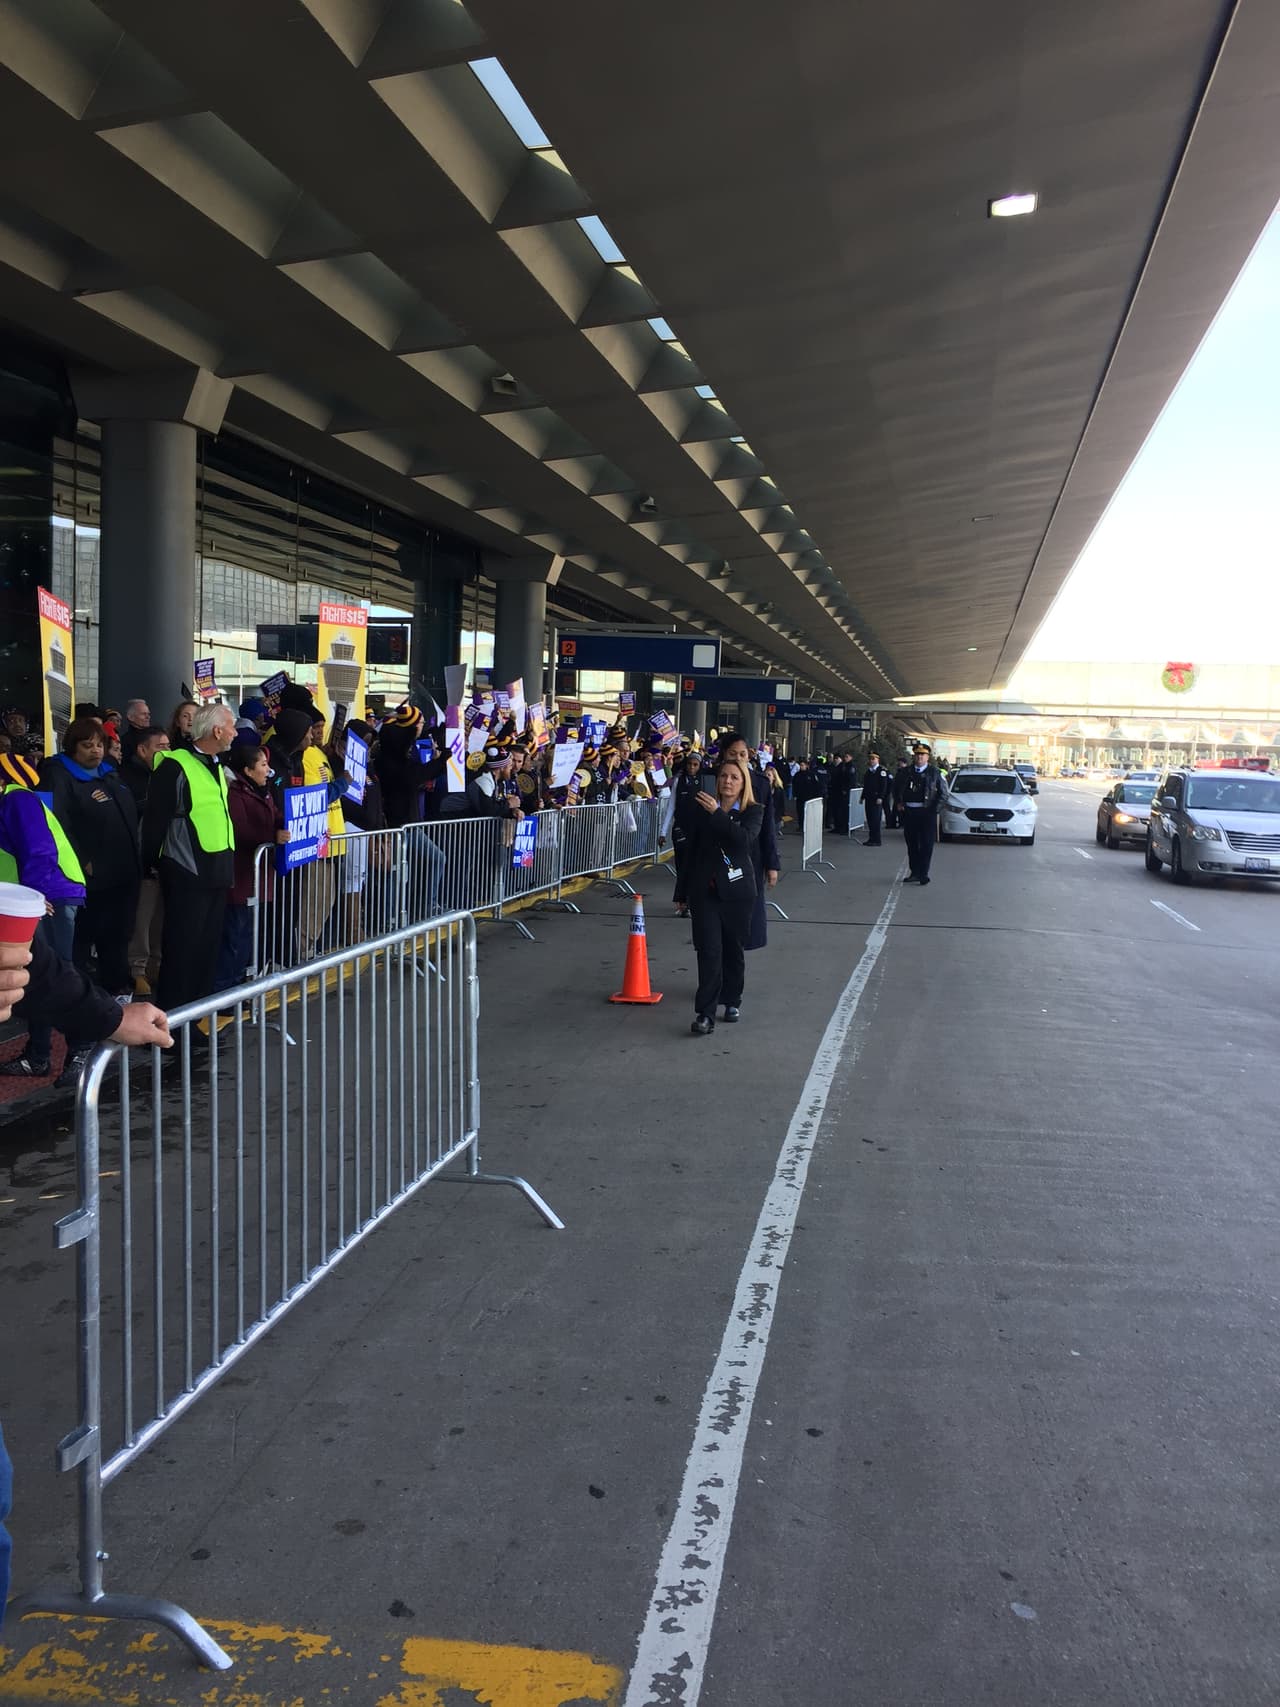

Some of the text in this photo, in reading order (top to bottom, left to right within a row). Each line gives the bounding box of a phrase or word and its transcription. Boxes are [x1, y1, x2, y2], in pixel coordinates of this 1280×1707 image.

[322, 606, 343, 624] FIGHT
[346, 610, 366, 626] $15
[566, 643, 573, 653] 2
[563, 656, 574, 664] 2E
[291, 794, 304, 818] WE
[304, 790, 326, 815] WON'T
[287, 812, 328, 843] BACK DOWN
[515, 836, 534, 850] OWN
